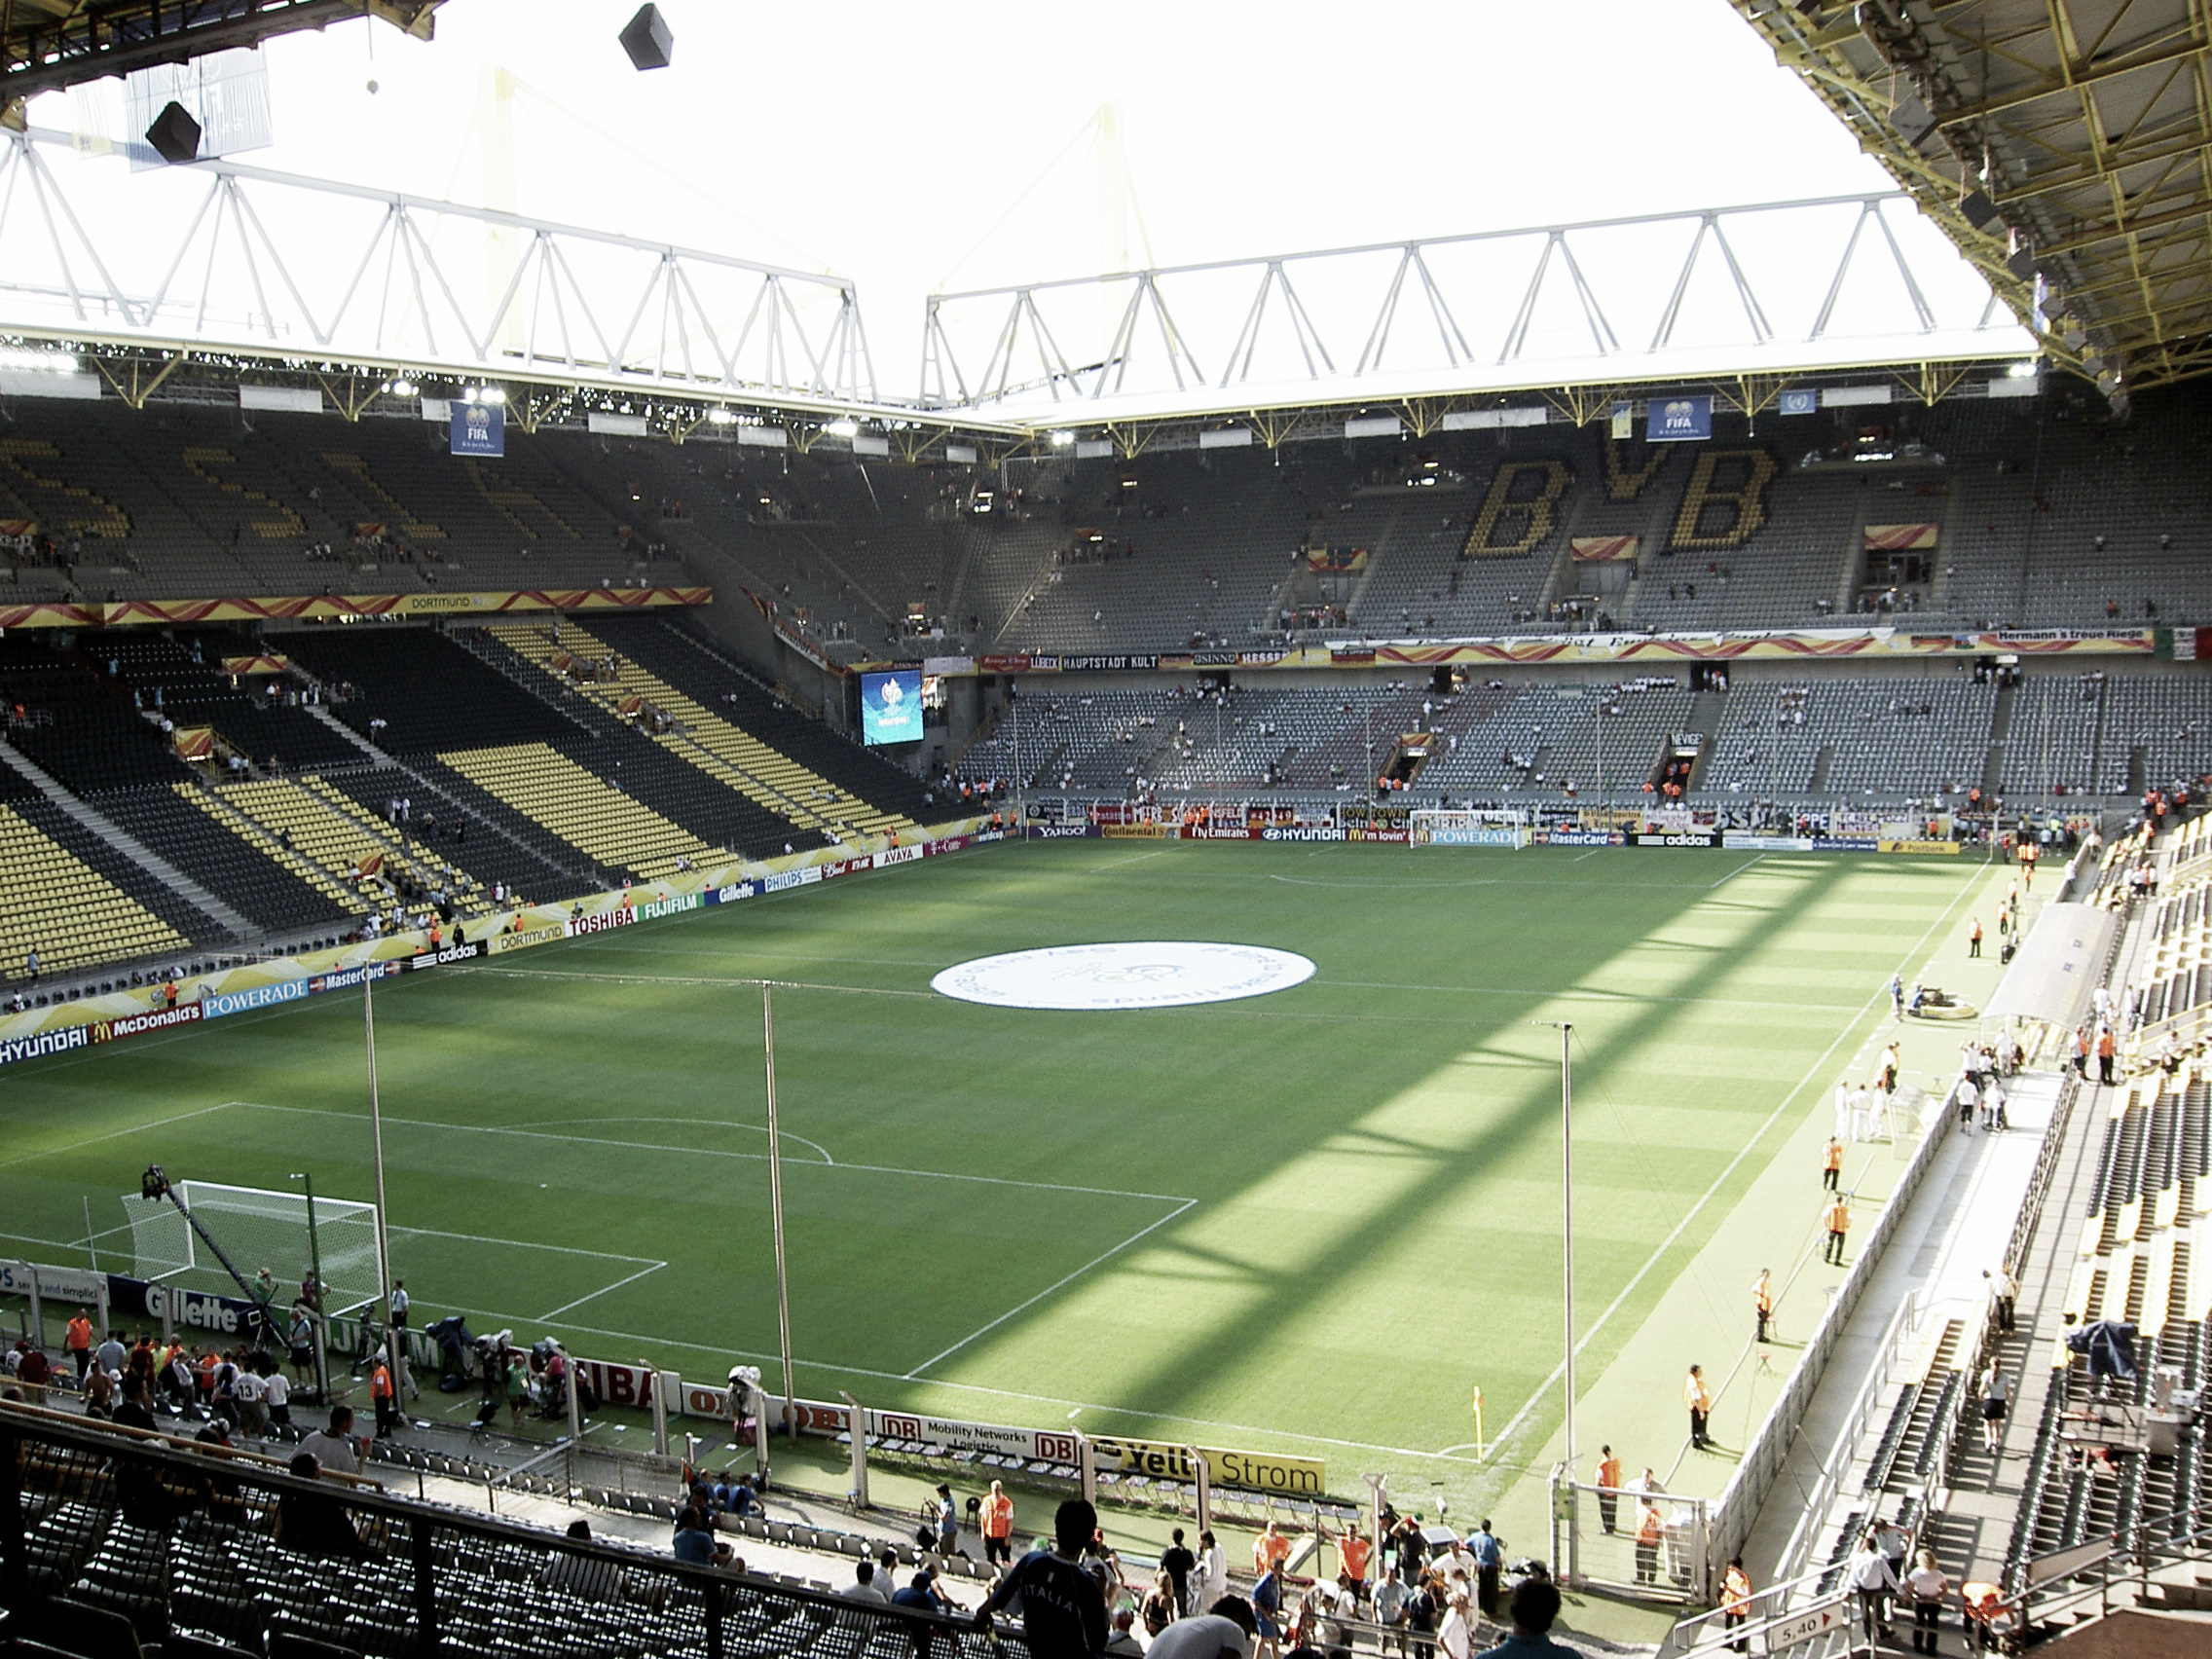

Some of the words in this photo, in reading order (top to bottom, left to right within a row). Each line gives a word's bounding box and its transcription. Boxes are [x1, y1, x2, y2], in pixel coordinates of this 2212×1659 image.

[1666, 418, 1692, 428] FIFA
[467, 428, 489, 441] FIFA
[412, 597, 470, 608] DORTMUND
[1063, 656, 1126, 669] HAUPTSTADT
[1131, 656, 1157, 668] KULT
[1208, 827, 1250, 839] Emirates
[1282, 829, 1346, 840] HYUNDAI
[1548, 832, 1607, 845] MasterCard
[1666, 834, 1712, 846] adidas
[884, 848, 914, 865] AVAYA
[766, 871, 802, 892] PHILIPS
[719, 882, 755, 903] Gillette
[645, 894, 697, 919] FUJIFILM
[570, 907, 633, 937] TOSHIBA
[500, 925, 563, 950] DORTMUND
[438, 942, 478, 964] adidas
[326, 963, 386, 989] MasterCard
[205, 978, 307, 1017] POWERADE
[114, 1004, 200, 1037] McDonald's
[239, 1384, 253, 1398] 13
[886, 1419, 916, 1438] DB
[928, 1421, 973, 1438] Mobility
[975, 1428, 1027, 1444] Networks
[954, 1438, 1001, 1452] Logistics
[1040, 1438, 1073, 1461] DB
[1222, 1454, 1318, 1491] Strom
[1024, 1583, 1073, 1613] ITALIA
